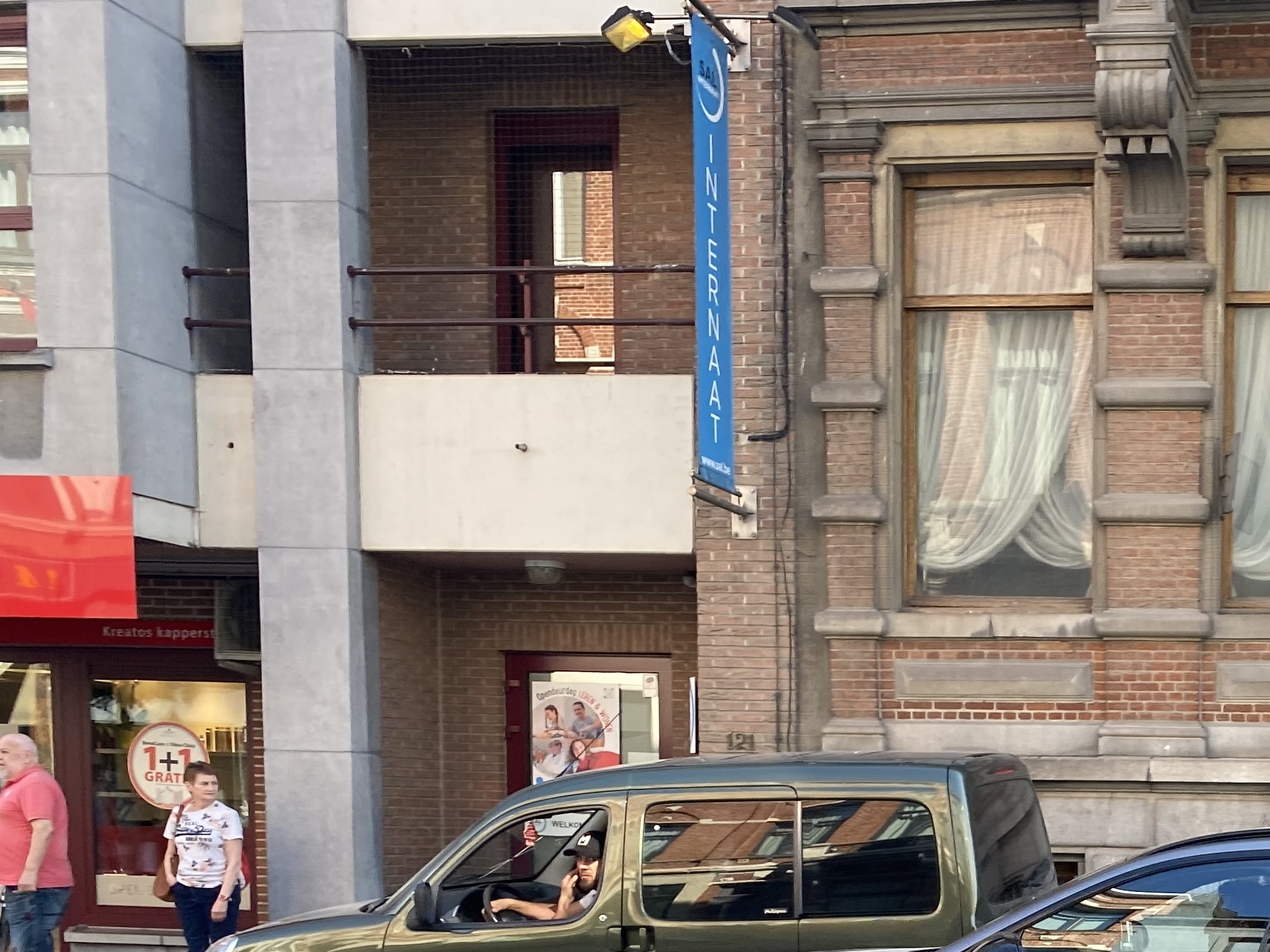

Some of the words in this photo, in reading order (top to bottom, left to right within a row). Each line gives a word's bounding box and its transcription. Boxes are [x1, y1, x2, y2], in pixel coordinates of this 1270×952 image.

[705, 134, 722, 443] INTERNAAT
[102, 626, 153, 638] Kreatos
[155, 627, 216, 640] kapperst
[726, 731, 756, 751] 121
[144, 771, 182, 784] GRAT
